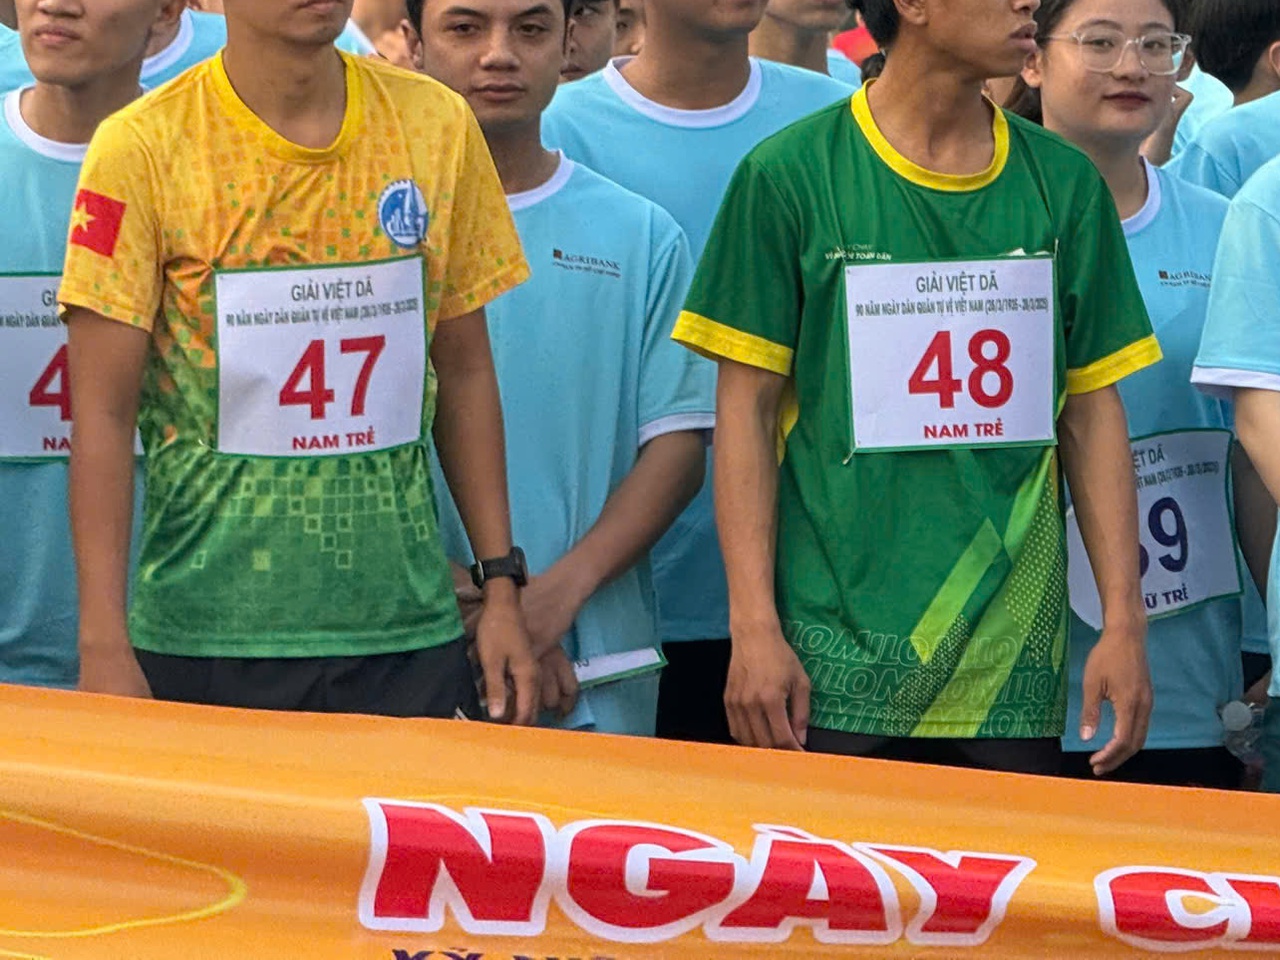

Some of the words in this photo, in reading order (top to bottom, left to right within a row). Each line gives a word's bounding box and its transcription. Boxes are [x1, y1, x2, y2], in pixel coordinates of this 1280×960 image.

[291, 278, 319, 301] GIẢI
[323, 278, 352, 303] VIỆT
[356, 276, 373, 297] DÃ
[916, 272, 943, 293] GIẢI
[947, 271, 975, 295] VIỆT
[980, 271, 998, 290] DÃ
[42, 289, 57, 307] GI
[279, 335, 386, 420] 47
[908, 329, 1013, 408] 48
[29, 343, 73, 421] 4
[293, 434, 339, 450] NAM
[346, 426, 375, 447] TRẺ
[924, 424, 969, 438] NAM
[975, 418, 1004, 436] TRẺ
[43, 437, 71, 451] NA
[1149, 444, 1165, 465] DÃ
[1140, 497, 1188, 578] 9
[1145, 593, 1157, 609] Ữ
[1162, 583, 1188, 605] TRẺ
[358, 797, 1037, 945] NGÀY
